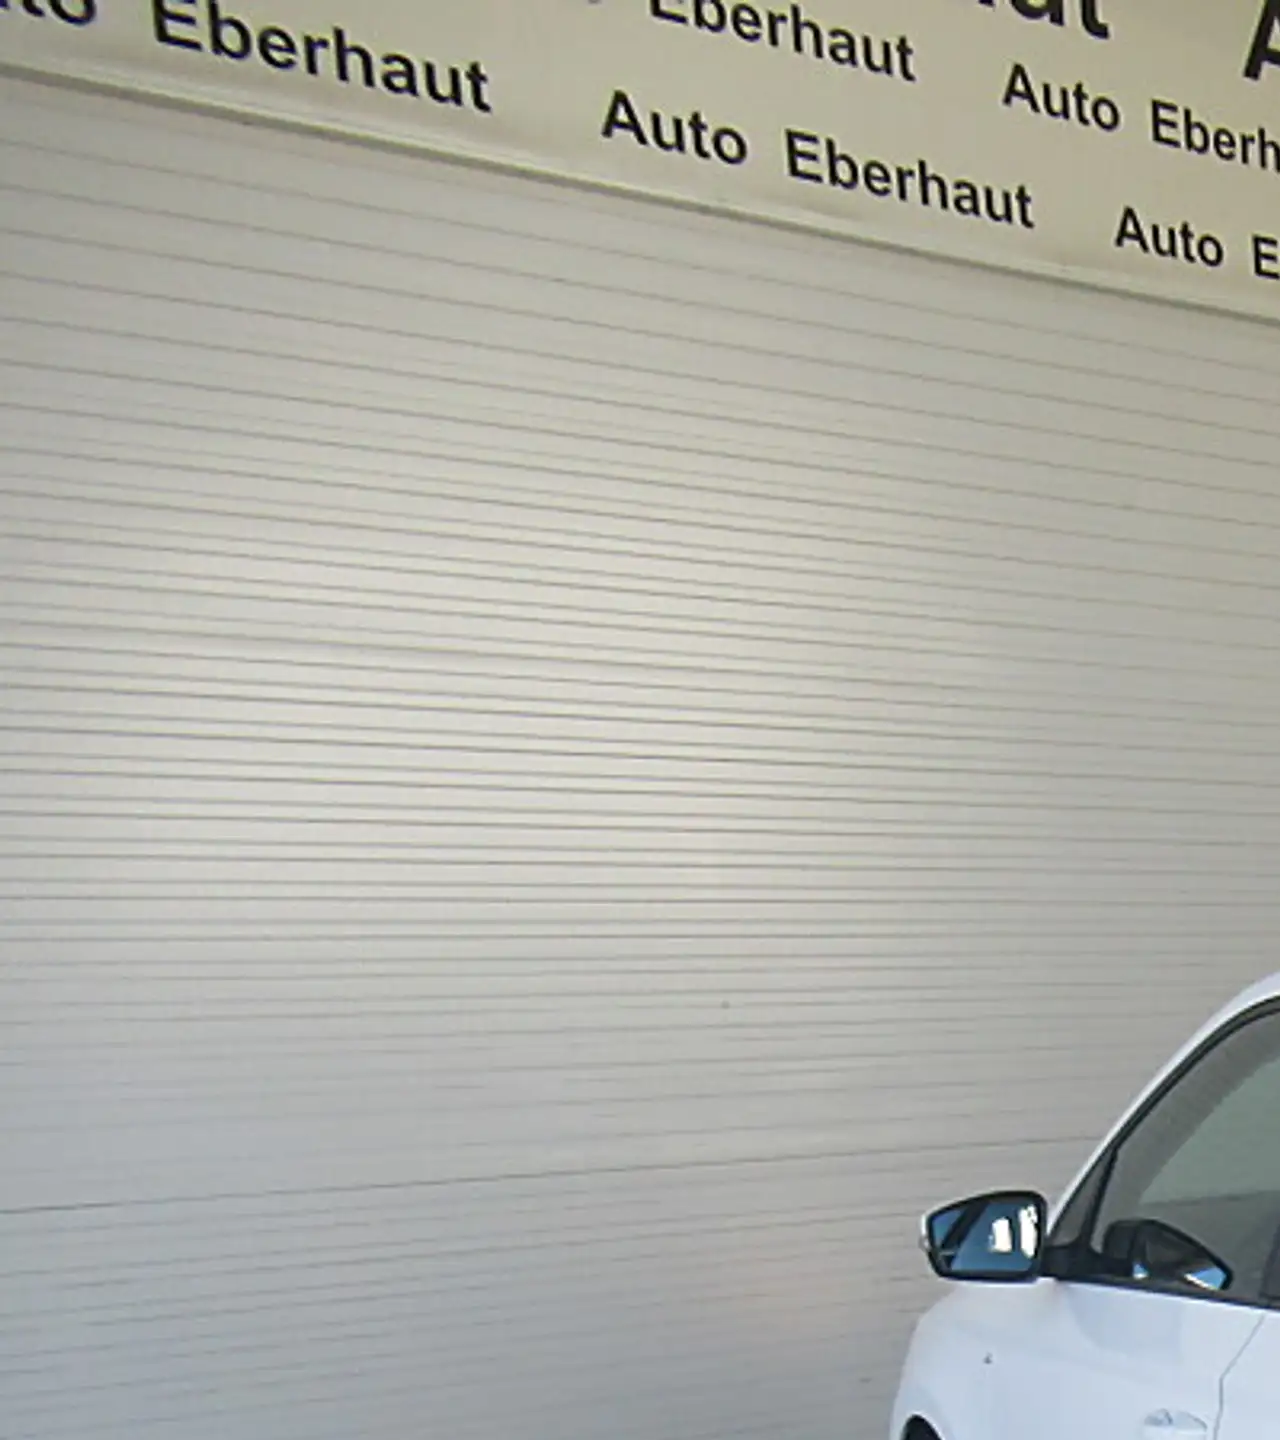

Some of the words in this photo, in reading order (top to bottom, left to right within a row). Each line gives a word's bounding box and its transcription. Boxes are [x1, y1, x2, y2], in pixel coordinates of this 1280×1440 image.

[151, 0, 492, 113] Eberhaut
[1002, 63, 1120, 132] Auto
[601, 90, 748, 165] Auto
[785, 128, 1035, 229] Eberhaut
[1115, 206, 1225, 268] Auto
